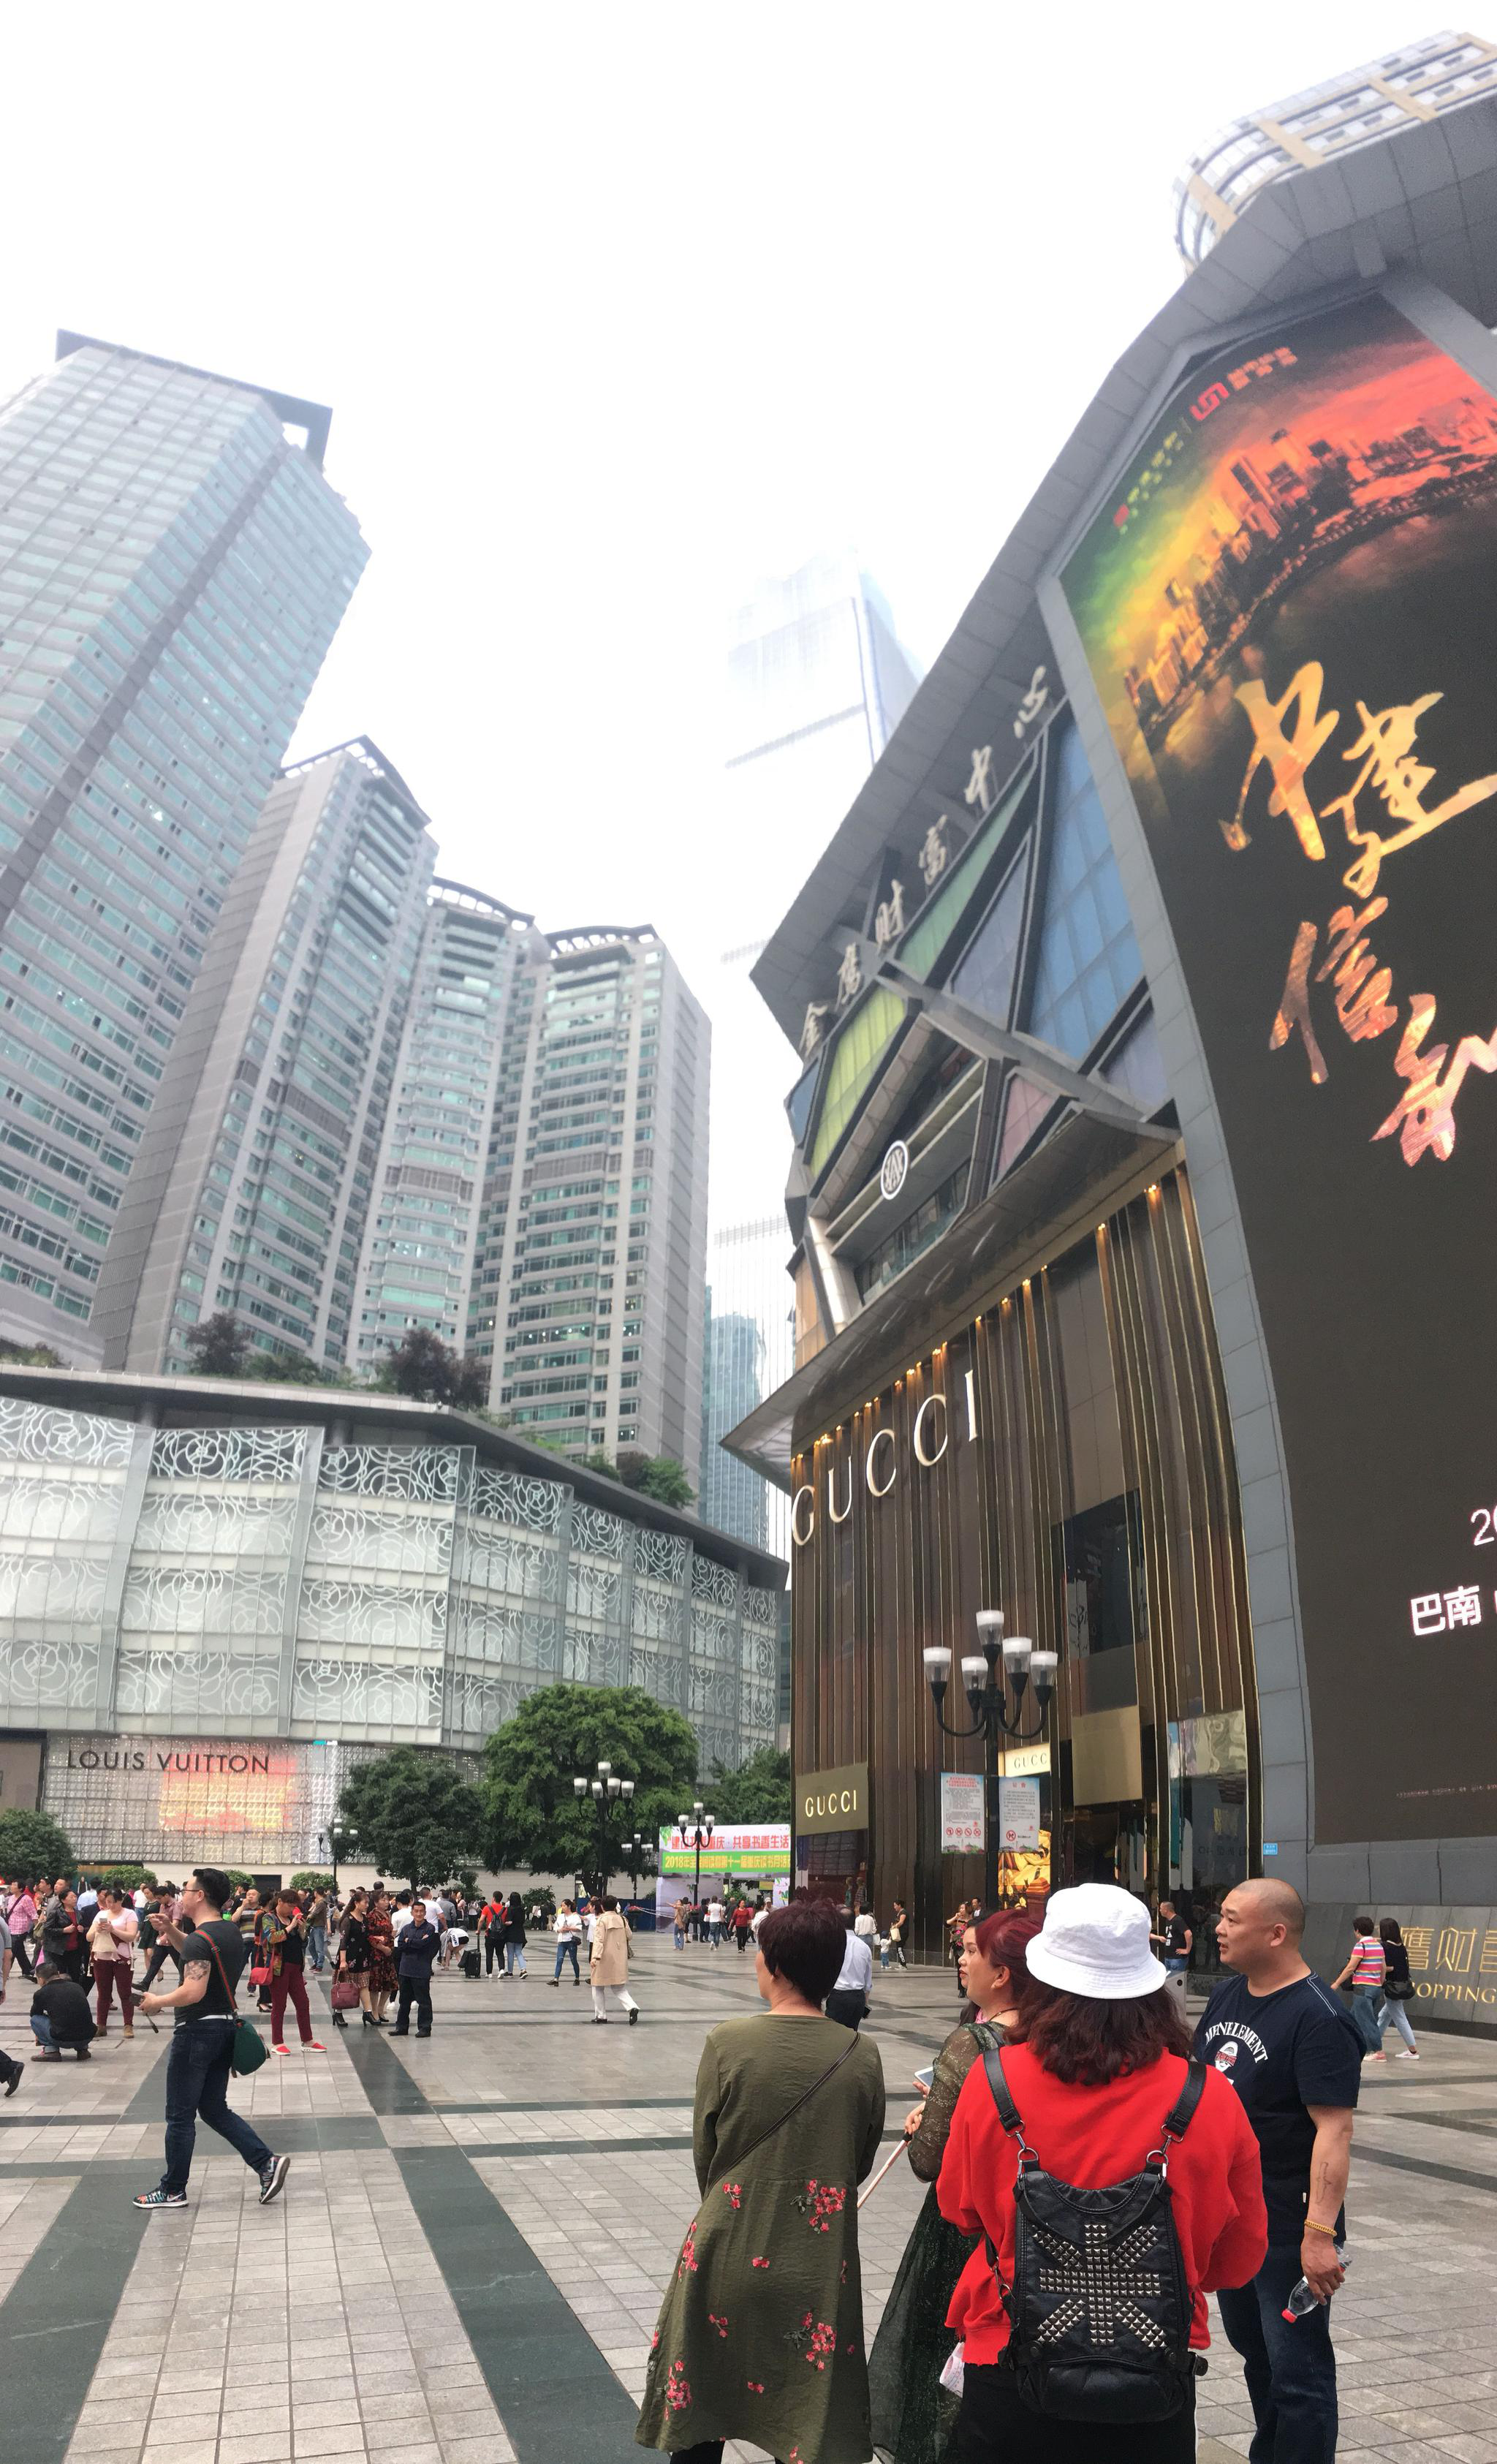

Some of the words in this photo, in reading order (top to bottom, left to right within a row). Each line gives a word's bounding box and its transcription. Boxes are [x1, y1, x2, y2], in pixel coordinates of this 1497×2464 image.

[792, 1369, 978, 1546] GUCCI
[1411, 1585, 1482, 1636] 巴南
[67, 1750, 145, 1770] LOUIS
[156, 1753, 269, 1773] VUITTON
[1014, 1753, 1047, 1769] GUCC
[805, 1789, 857, 1818] GUCCI
[1412, 1982, 1497, 2003] OPPING
